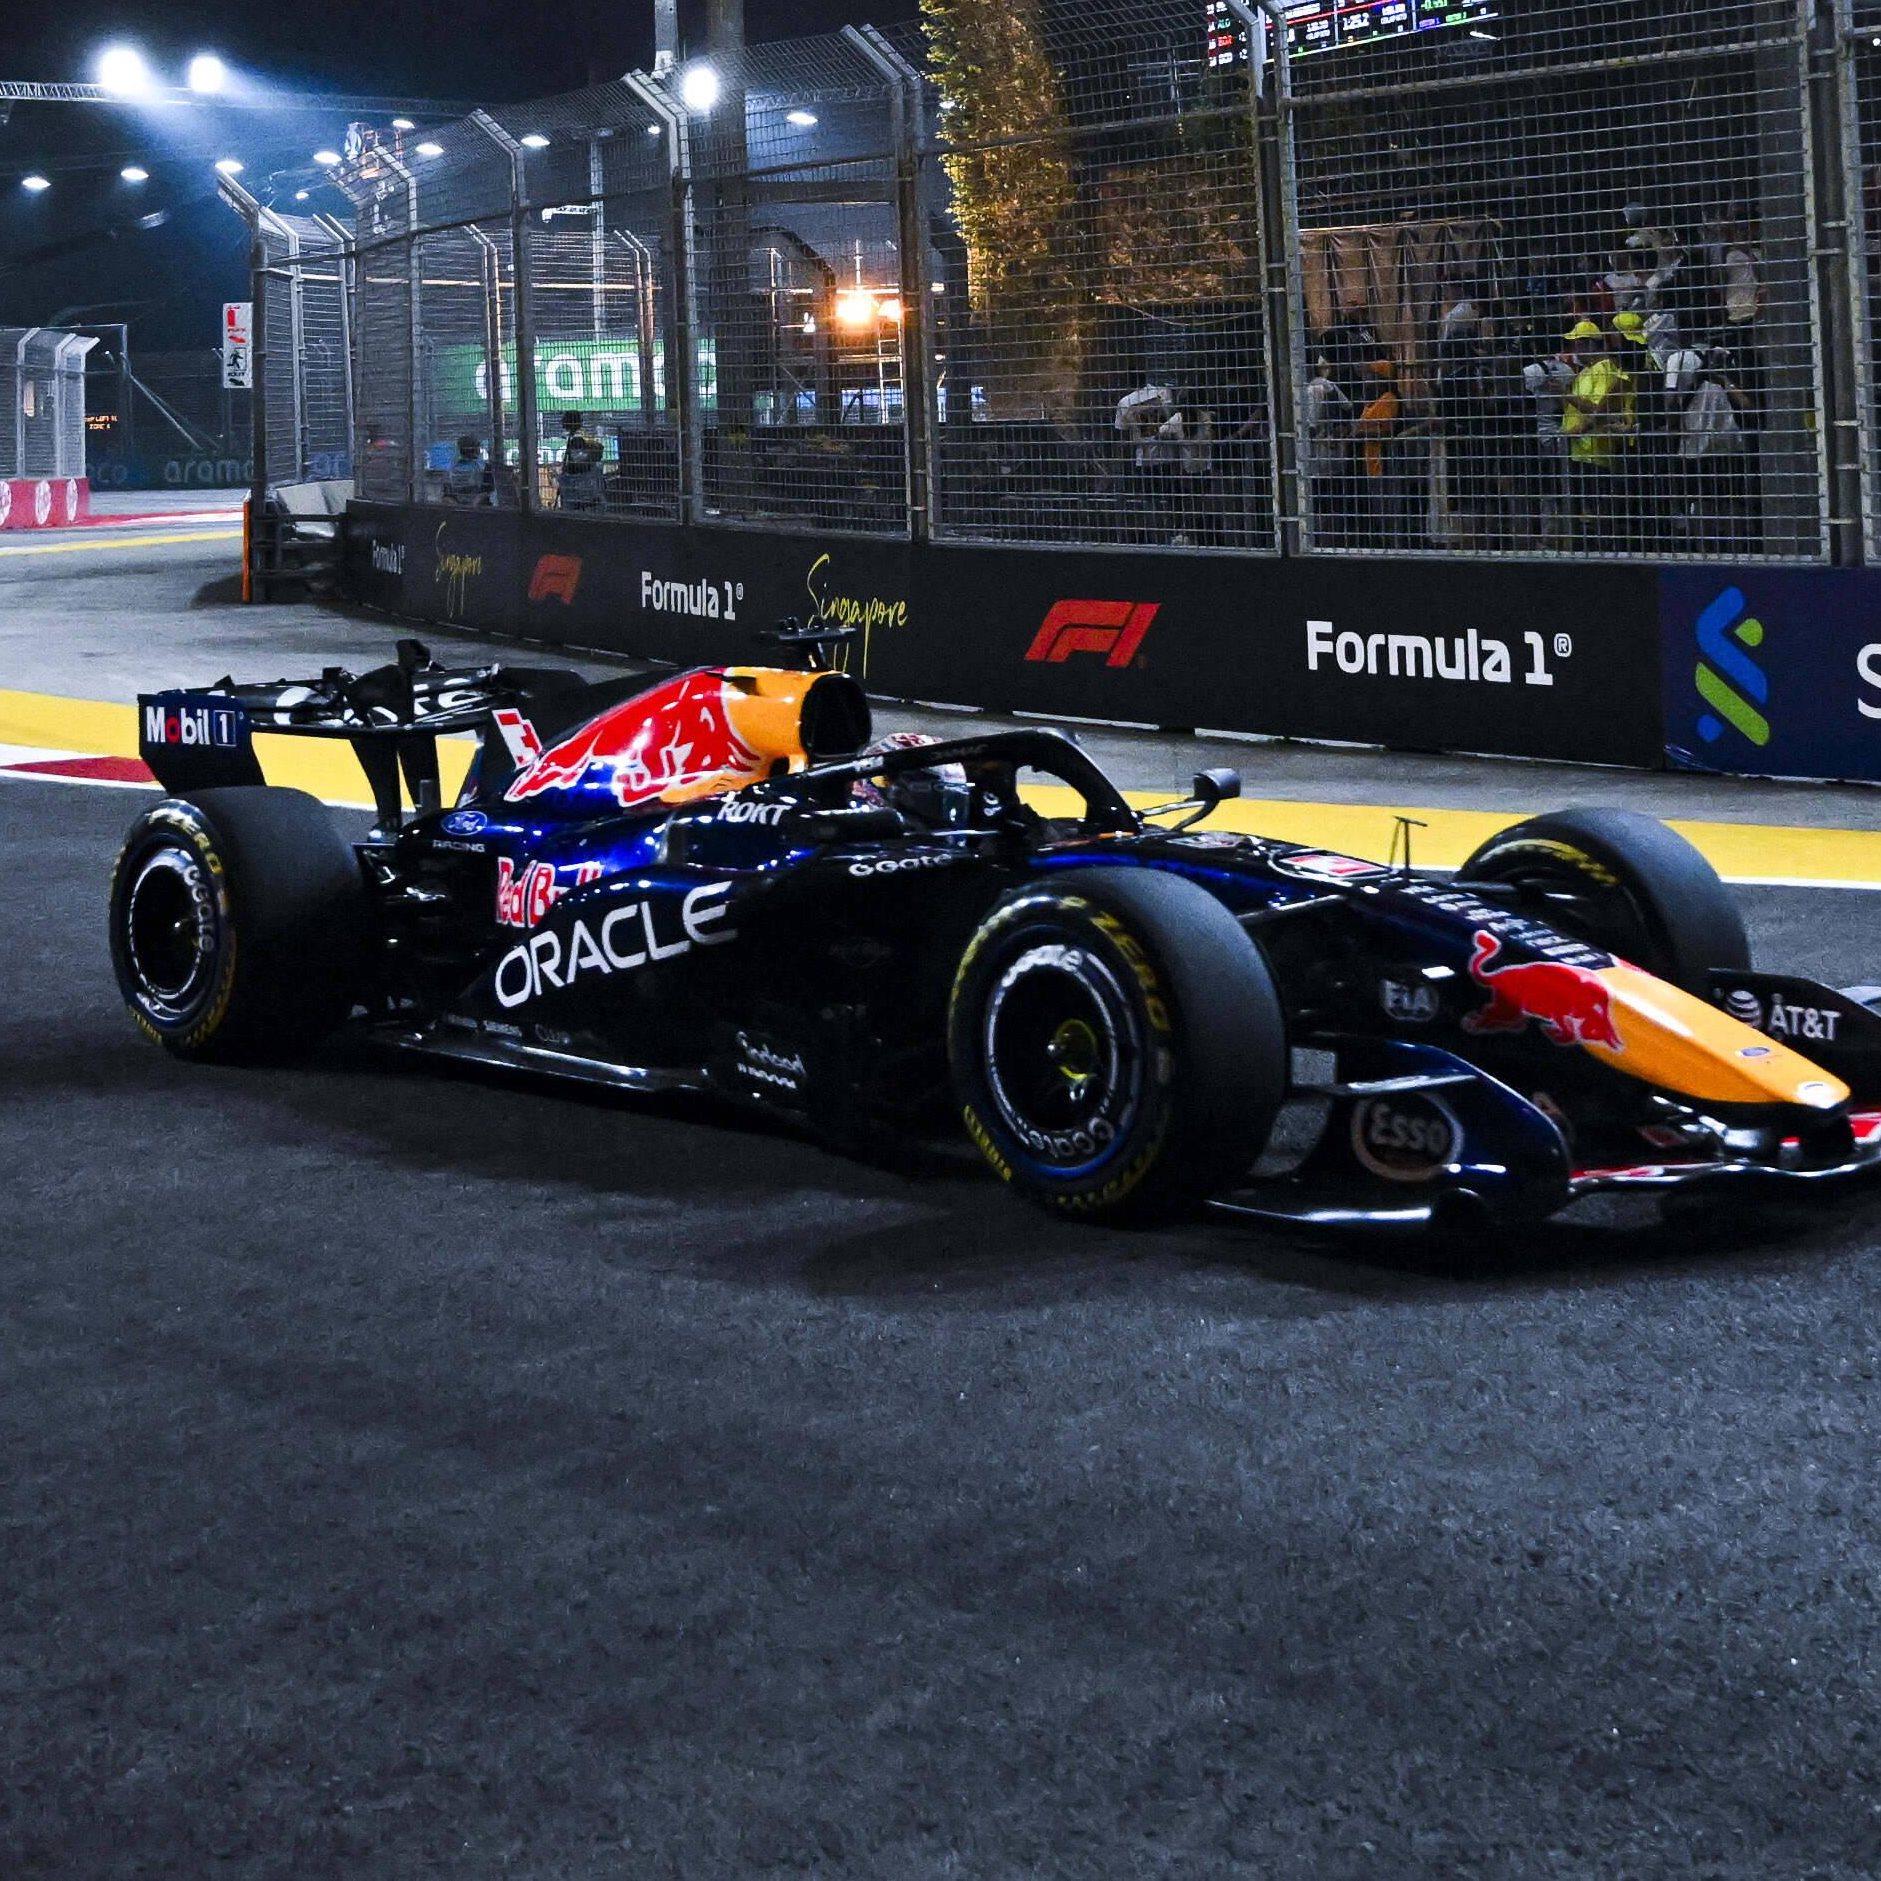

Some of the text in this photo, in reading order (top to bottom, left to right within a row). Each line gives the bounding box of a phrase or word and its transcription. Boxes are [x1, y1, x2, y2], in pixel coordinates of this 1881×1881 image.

[641, 570, 720, 619] Formula
[1023, 598, 1161, 668] F1
[1306, 620, 1512, 683] Formula
[146, 705, 210, 745] Mobil
[717, 800, 793, 826] ROKT
[432, 839, 486, 853] RACING
[495, 880, 738, 1008] ORACLE
[1770, 1002, 1842, 1041] AT&T
